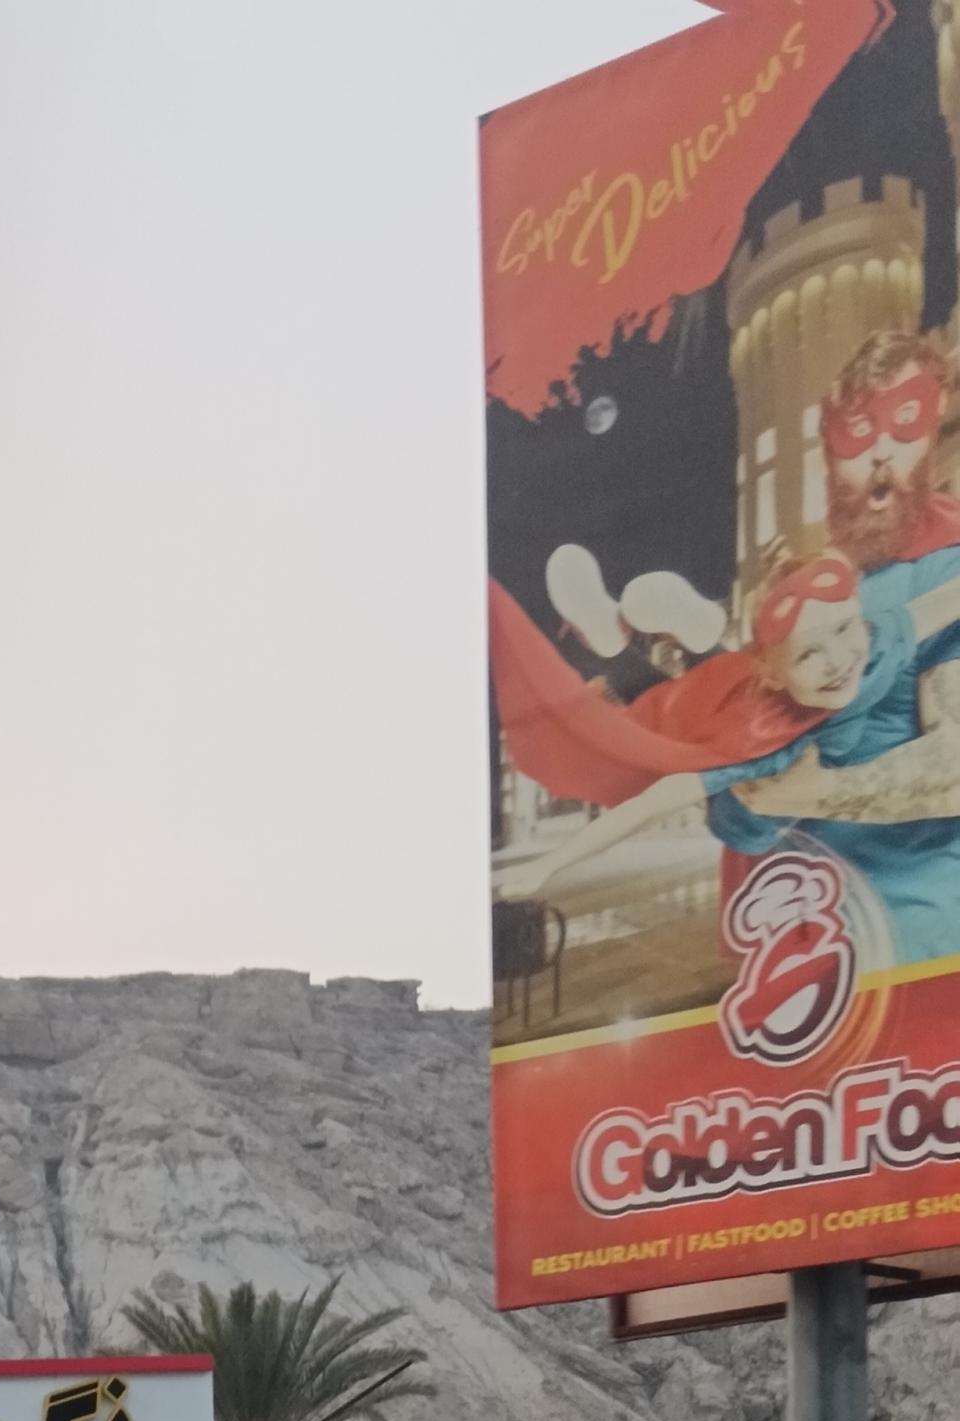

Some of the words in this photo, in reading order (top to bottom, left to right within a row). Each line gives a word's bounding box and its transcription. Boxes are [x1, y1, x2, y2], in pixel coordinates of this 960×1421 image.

[571, 21, 806, 284] Delicious
[497, 168, 598, 275] Super
[581, 1098, 829, 1209] Golden
[531, 1238, 670, 1277] RESTAURANT
[687, 1218, 807, 1253] FASTFOOD
[823, 1201, 911, 1232] COFFEE
